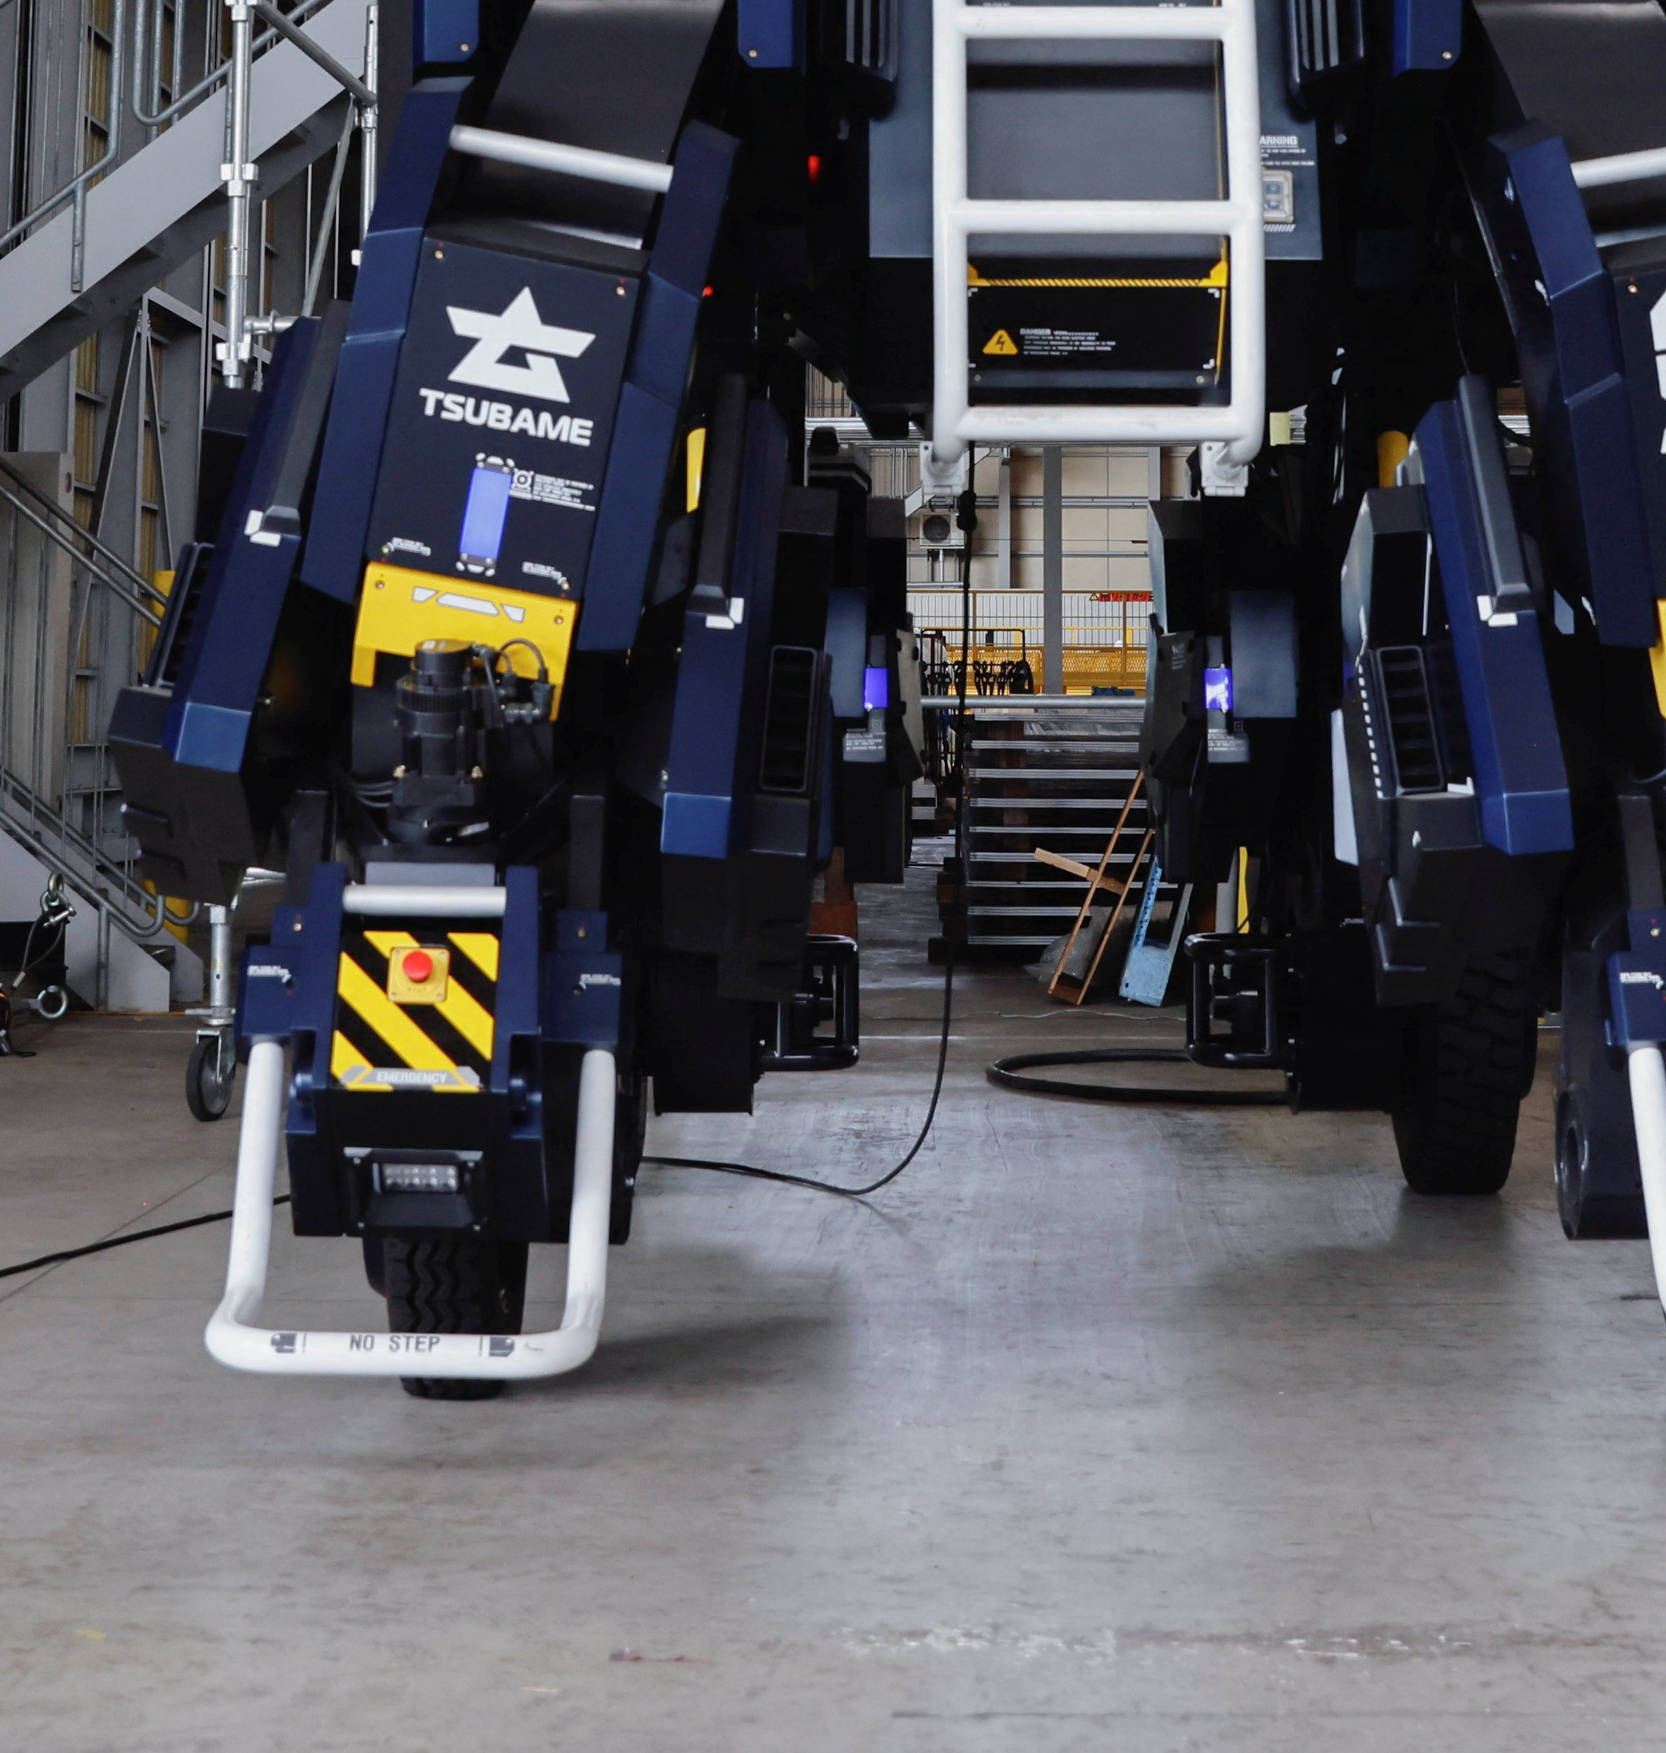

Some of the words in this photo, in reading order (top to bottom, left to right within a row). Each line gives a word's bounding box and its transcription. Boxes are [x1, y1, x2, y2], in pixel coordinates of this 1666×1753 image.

[1259, 135, 1298, 145] ARNING
[419, 388, 594, 447] TSUBAME
[377, 1071, 447, 1083] EMERGENCY
[349, 1334, 375, 1352] NO
[388, 1334, 441, 1352] STEP
